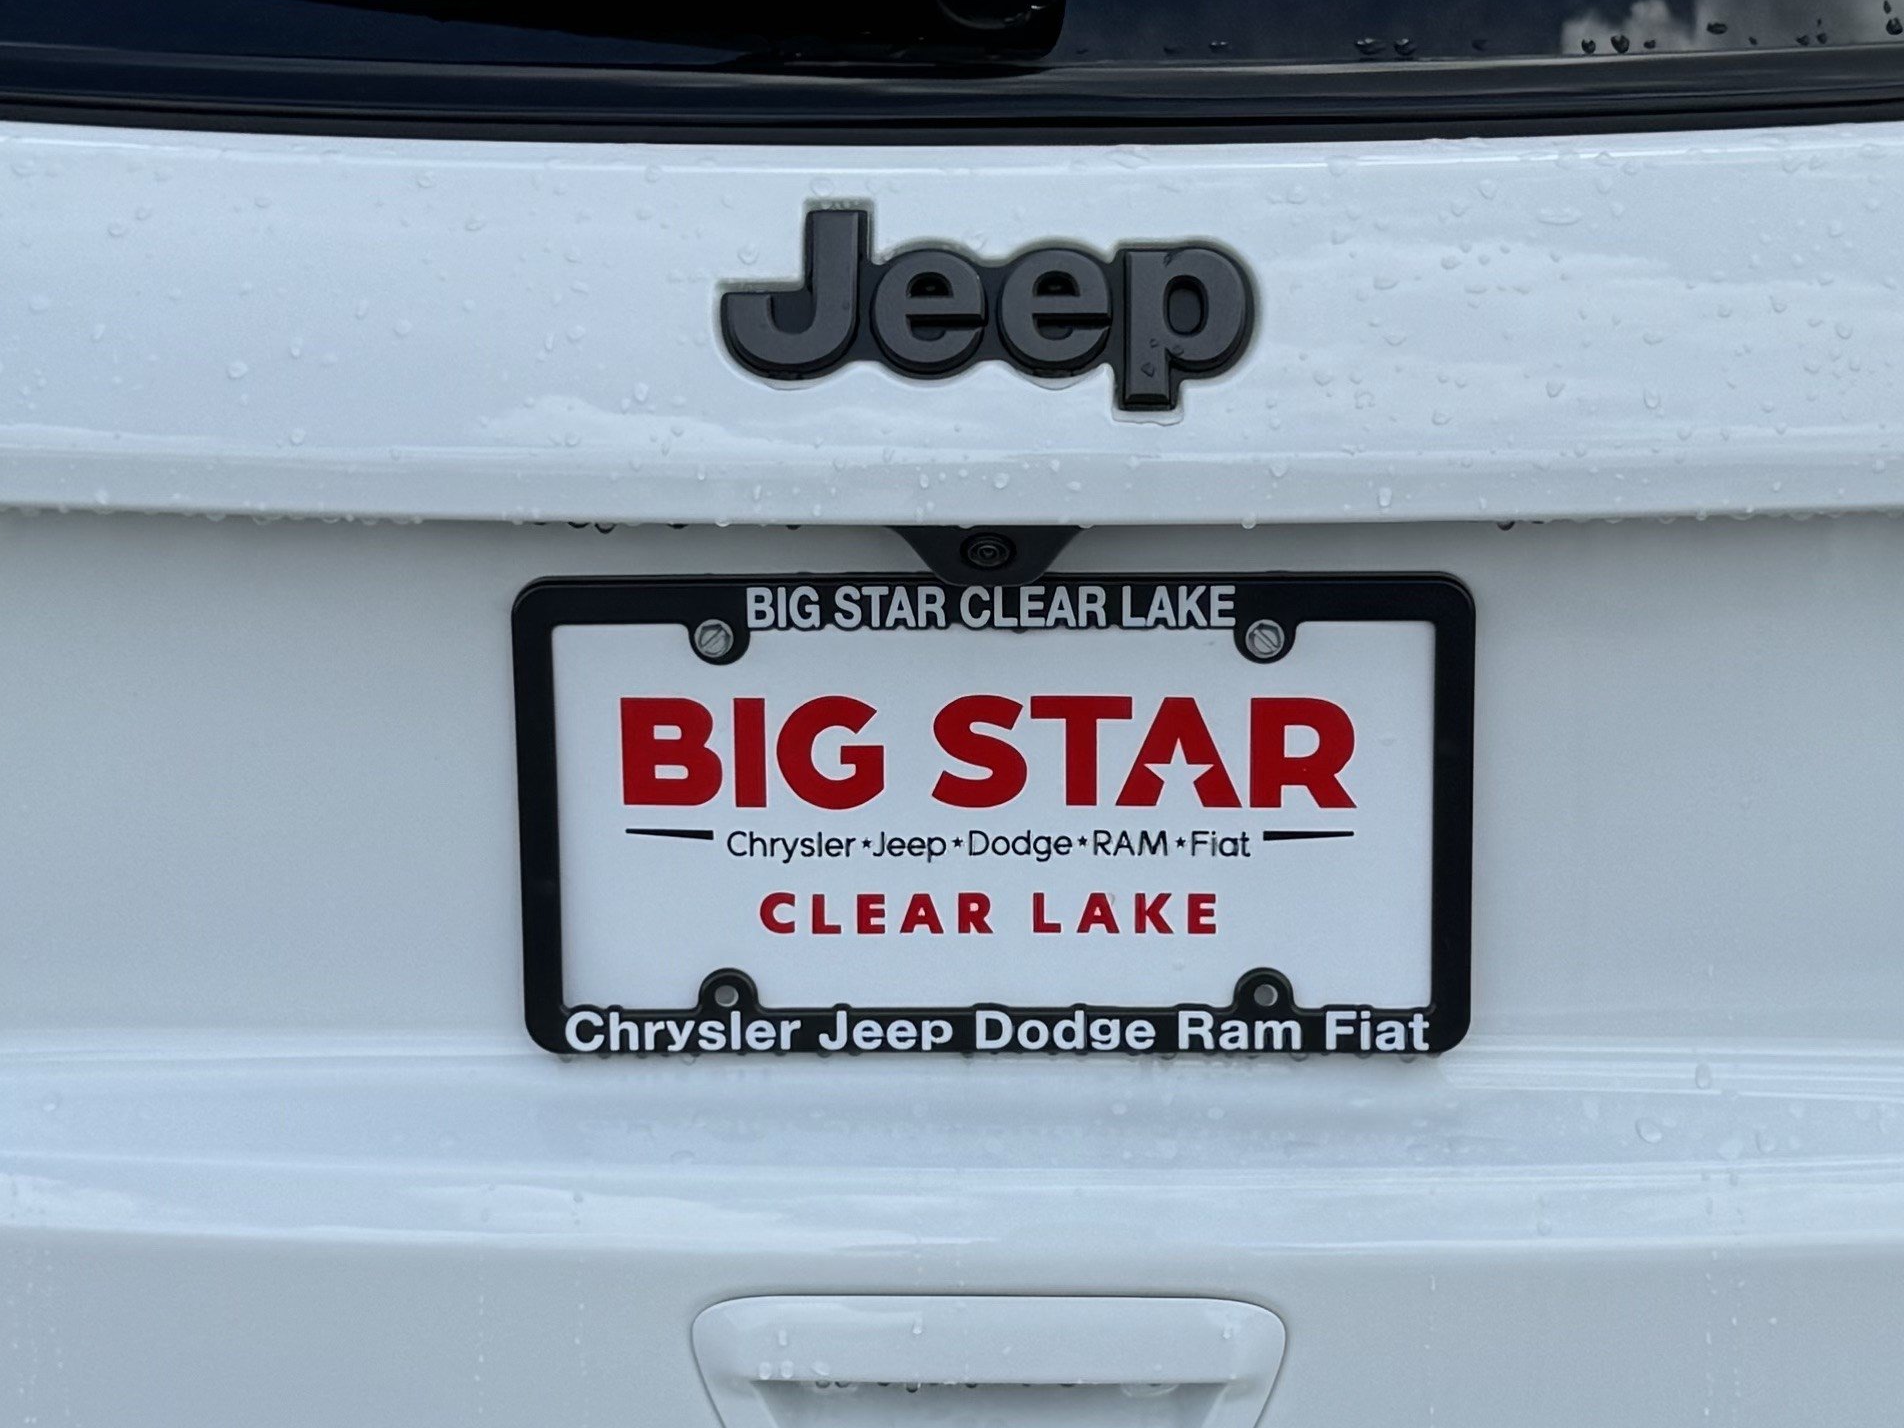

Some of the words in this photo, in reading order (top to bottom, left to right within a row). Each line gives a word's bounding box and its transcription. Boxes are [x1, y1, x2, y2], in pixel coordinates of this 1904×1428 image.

[720, 209, 1256, 412] Jeep
[746, 585, 821, 629] BIG
[834, 585, 946, 628] STAR
[959, 585, 1107, 628] CLEAR
[1121, 585, 1236, 628] LAKE
[620, 695, 884, 810] BIG
[931, 695, 1357, 810] STAR
[727, 830, 856, 864] Chrysler
[872, 830, 947, 863] Jeep
[968, 829, 1073, 863] Dodge
[1093, 829, 1168, 857] RAM
[1191, 830, 1251, 858] Fiat
[760, 892, 994, 935] CLEAR
[1033, 892, 1217, 934] LAKE
[564, 1010, 802, 1053] Chrysler
[818, 1010, 953, 1052] Jeep
[975, 1010, 1157, 1051] Dodge
[1178, 1010, 1302, 1051] Ram
[1325, 1010, 1430, 1051] Fiat
